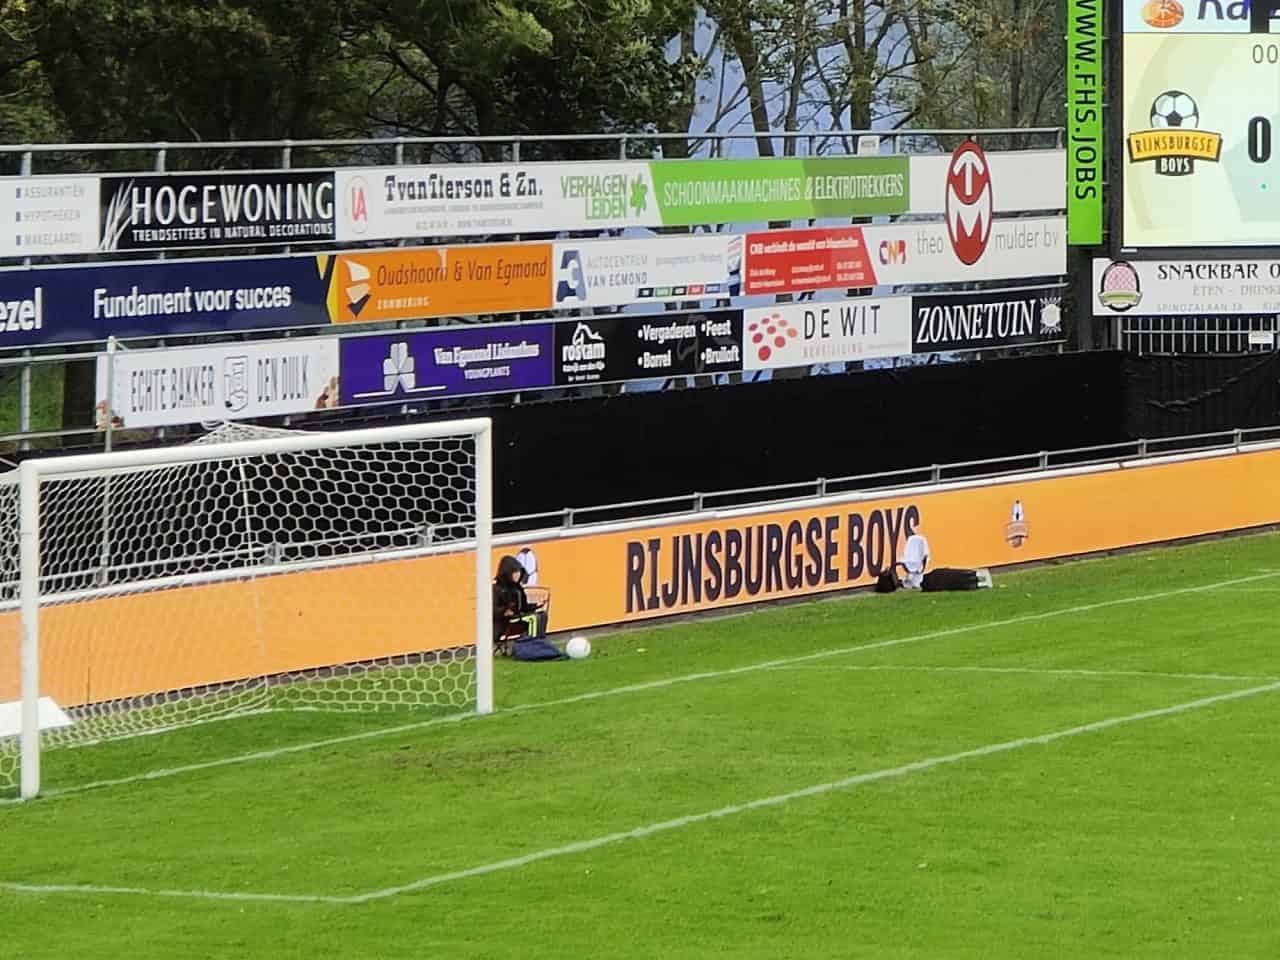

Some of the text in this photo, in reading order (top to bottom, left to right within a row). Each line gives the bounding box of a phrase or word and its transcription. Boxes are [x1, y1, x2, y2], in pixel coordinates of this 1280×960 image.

[1135, 135, 1214, 153] RIJNSBURGSE
[1161, 157, 1191, 173] BOYS
[500, 173, 511, 197] &
[560, 174, 627, 198] VERHAGEN
[663, 177, 800, 206] SCHOONMAAKMACHINES
[815, 173, 903, 200] ELEKTROTREKKERS
[132, 182, 333, 224] HOGEWONING
[585, 196, 627, 220] LEIDEN
[132, 223, 333, 241] TRENDSETTERS IN NATURAL DECORATIONS
[916, 230, 944, 255] theo
[995, 226, 1039, 250] mulder
[468, 260, 492, 282] Van
[497, 256, 547, 286] Egmond
[587, 271, 648, 288] VAN EGMOND
[1157, 263, 1258, 280] SNACKBAR
[94, 287, 191, 318] Fundament
[195, 291, 232, 312] voor
[236, 285, 292, 310] succes
[642, 322, 697, 344] Vergaderen
[706, 320, 732, 337] Feest
[804, 304, 880, 339] DE WIT
[916, 299, 1036, 344] ZONNETUIN
[643, 350, 672, 369] Borrel
[626, 515, 839, 614] RIJNSBURGSE
